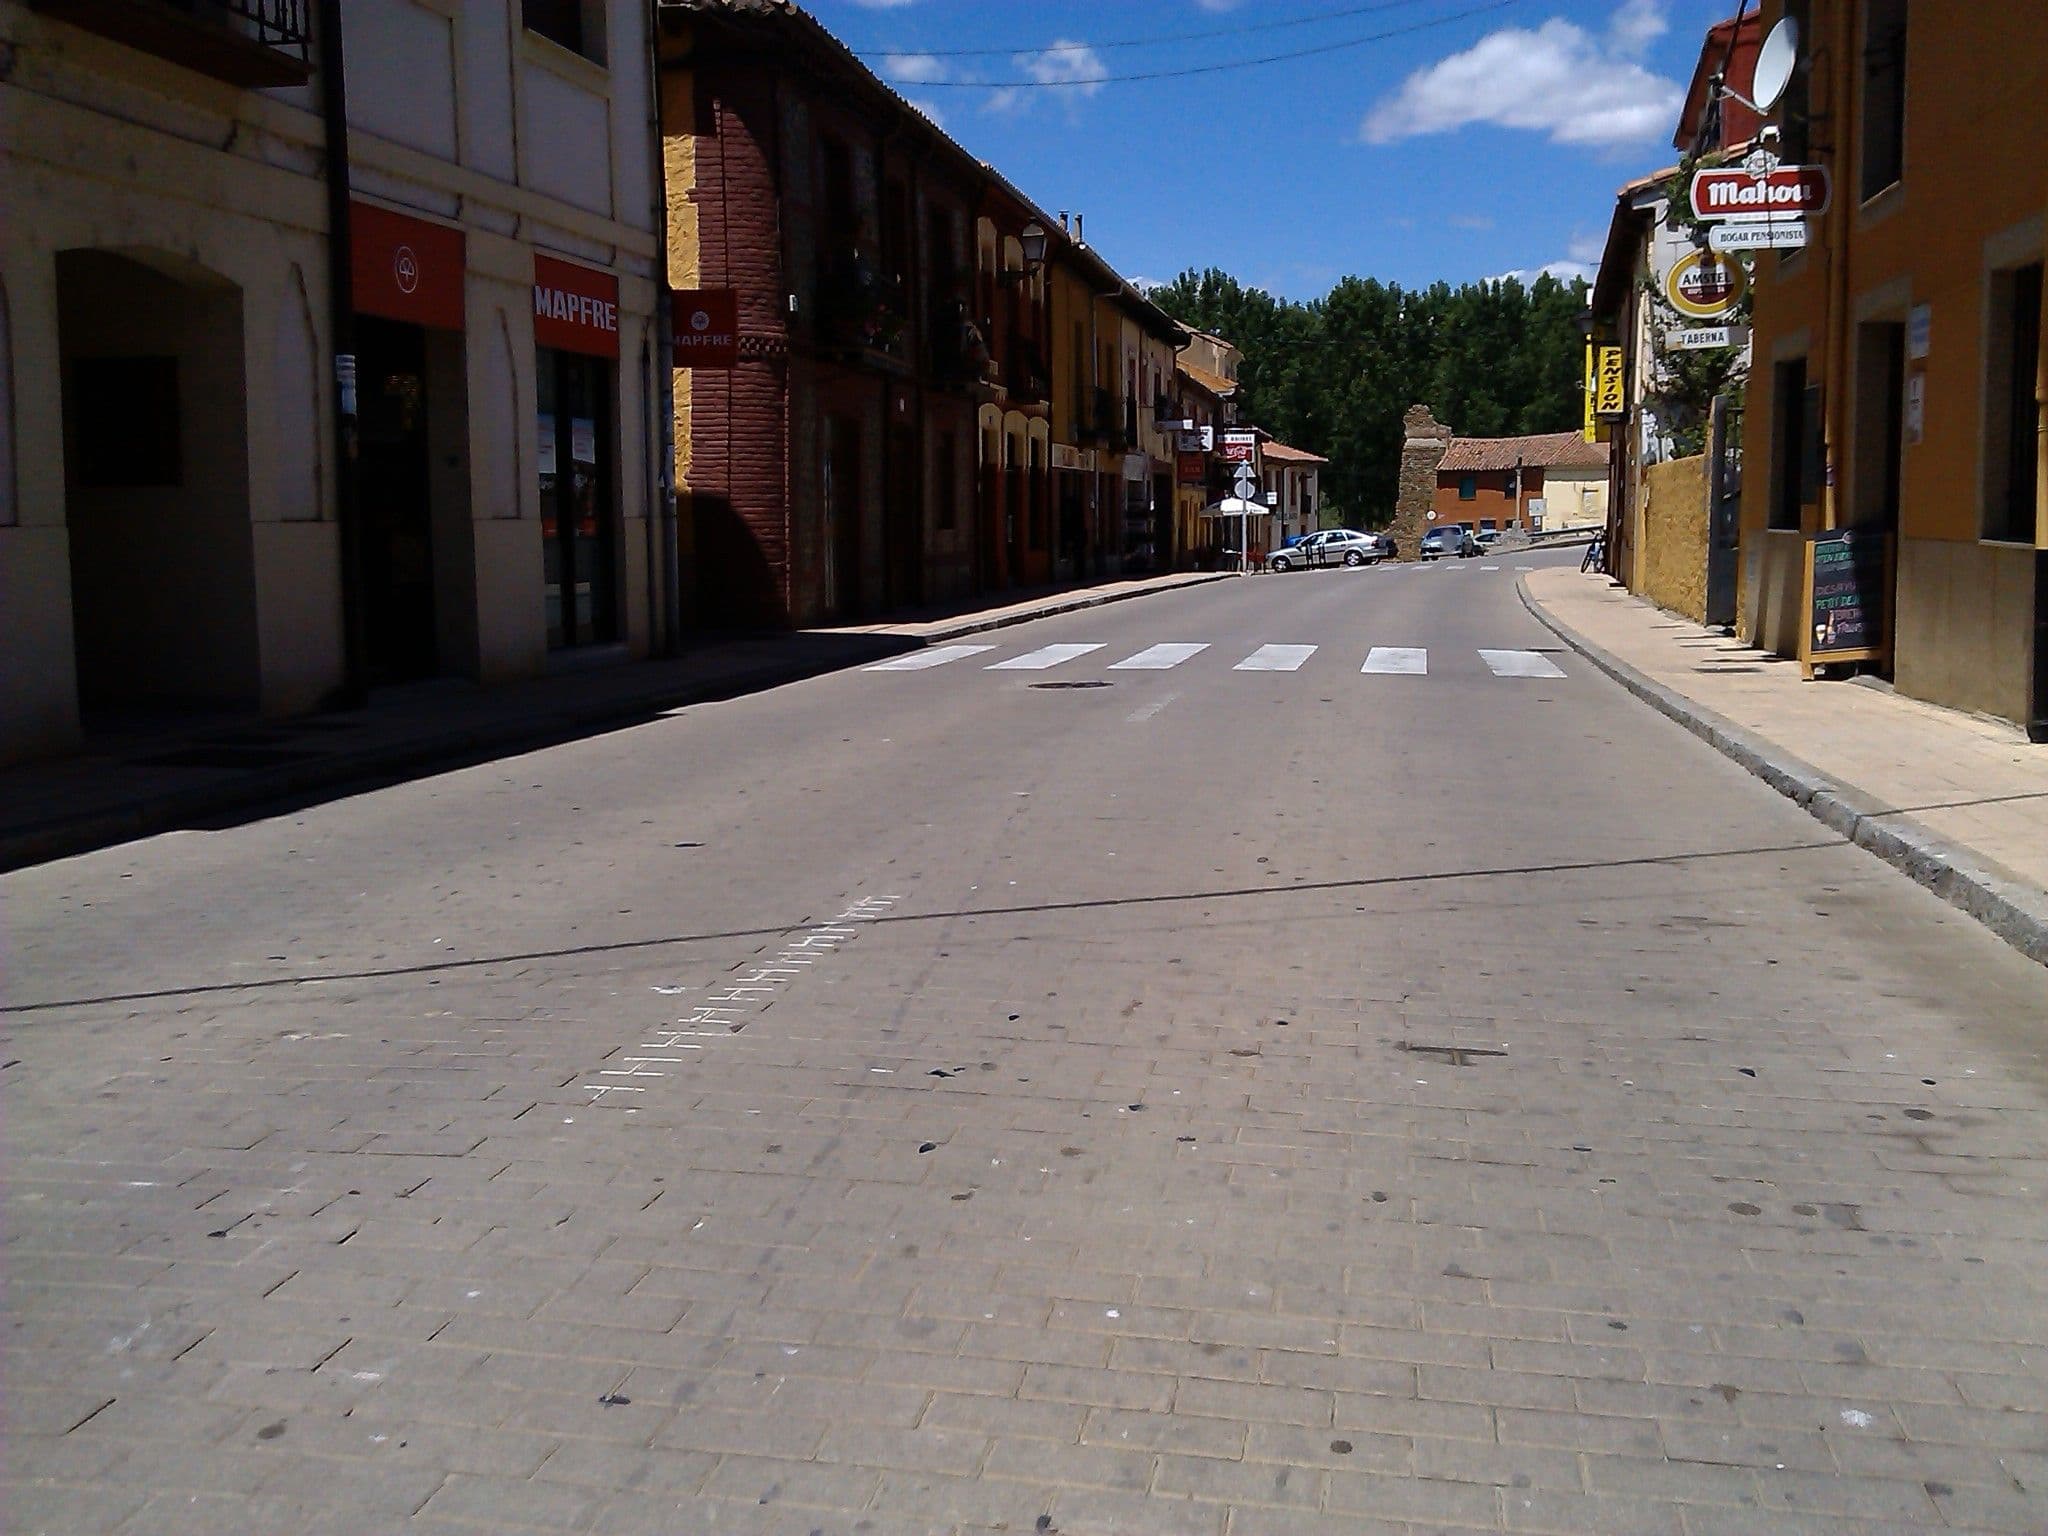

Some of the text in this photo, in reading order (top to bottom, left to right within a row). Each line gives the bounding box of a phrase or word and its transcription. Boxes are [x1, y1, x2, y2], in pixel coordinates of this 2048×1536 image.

[1707, 180, 1811, 206] Mahou
[1720, 229, 1804, 243] HOGAR PENSIONISTA
[1682, 272, 1732, 286] AMSTEL
[534, 284, 617, 332] MAPFRE
[1681, 332, 1725, 345] TABERNA
[1601, 350, 1622, 410] PENSION
